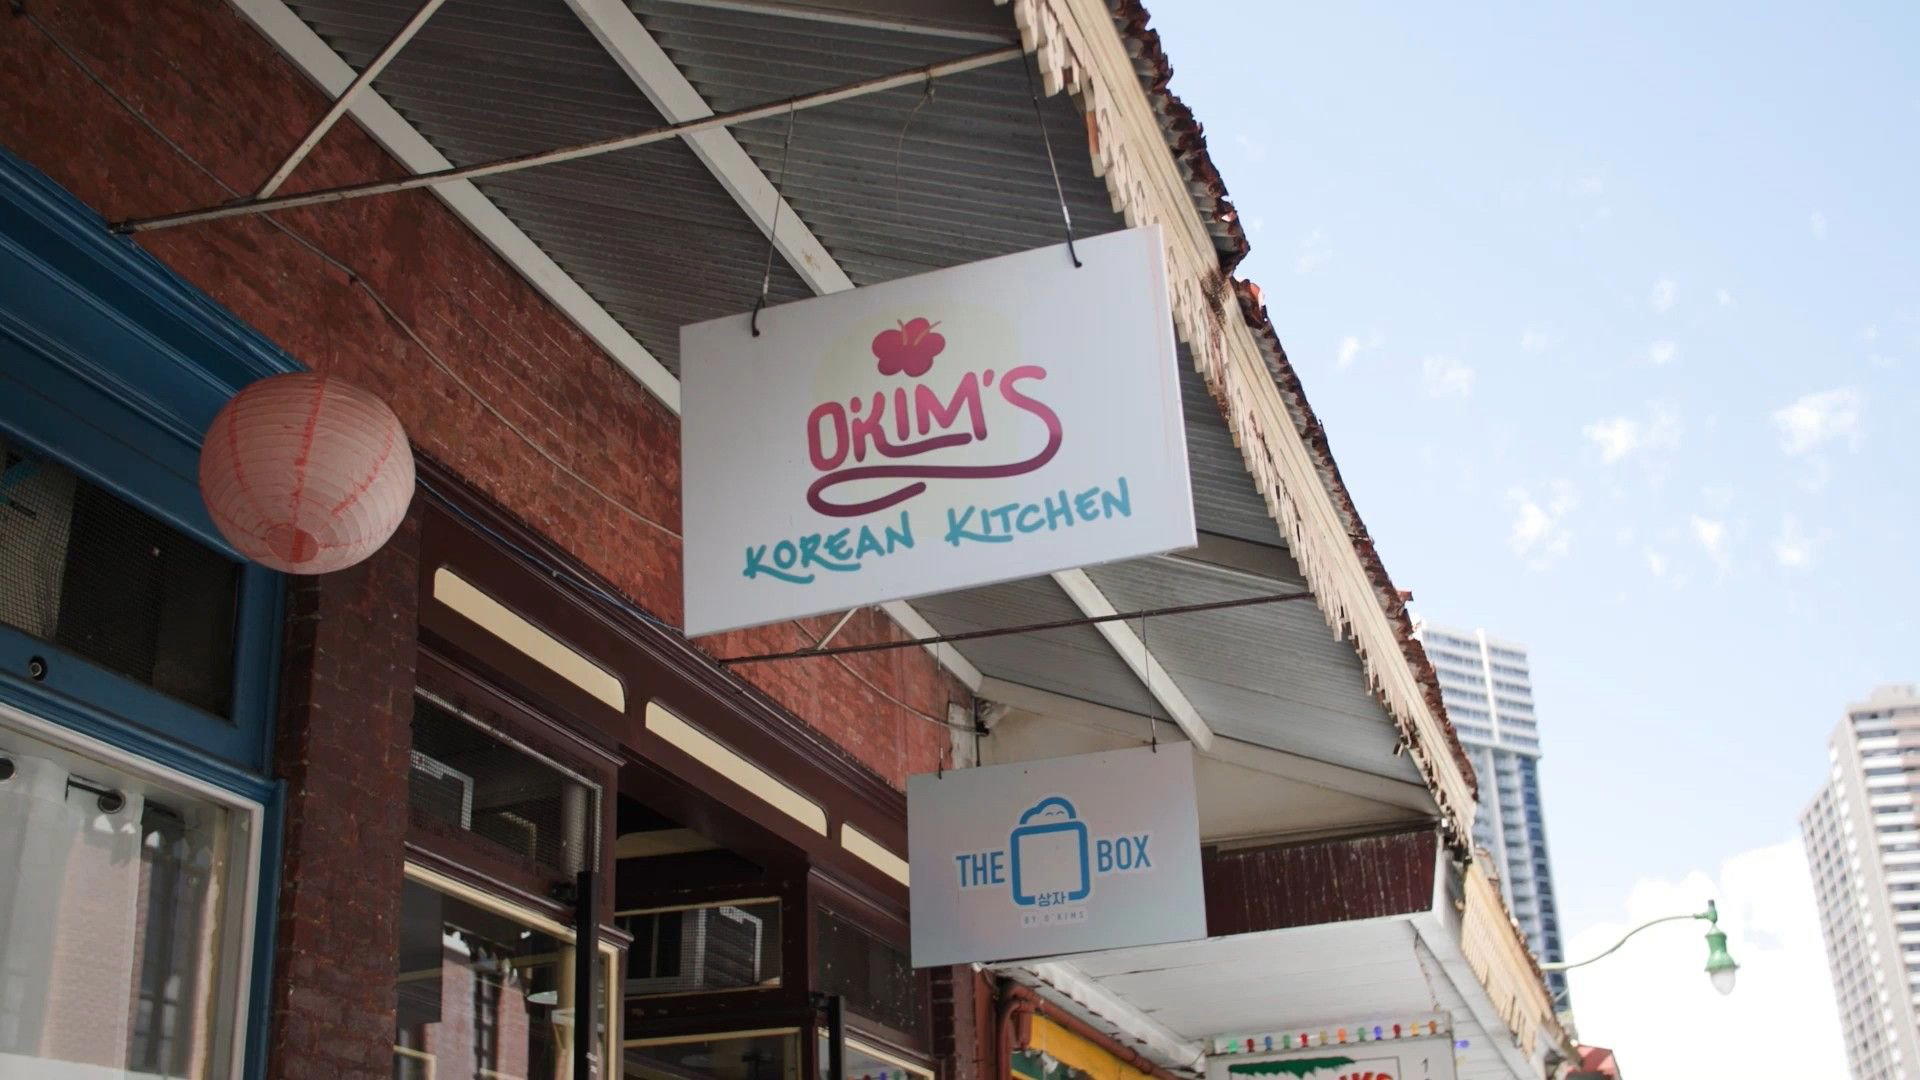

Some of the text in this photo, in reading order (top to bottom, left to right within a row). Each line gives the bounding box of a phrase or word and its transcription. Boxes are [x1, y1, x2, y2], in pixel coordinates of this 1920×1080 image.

[743, 477, 1133, 584] KOREAN KITCHEN
[956, 835, 1151, 887] THE BOX
[1038, 891, 1065, 907] 상자
